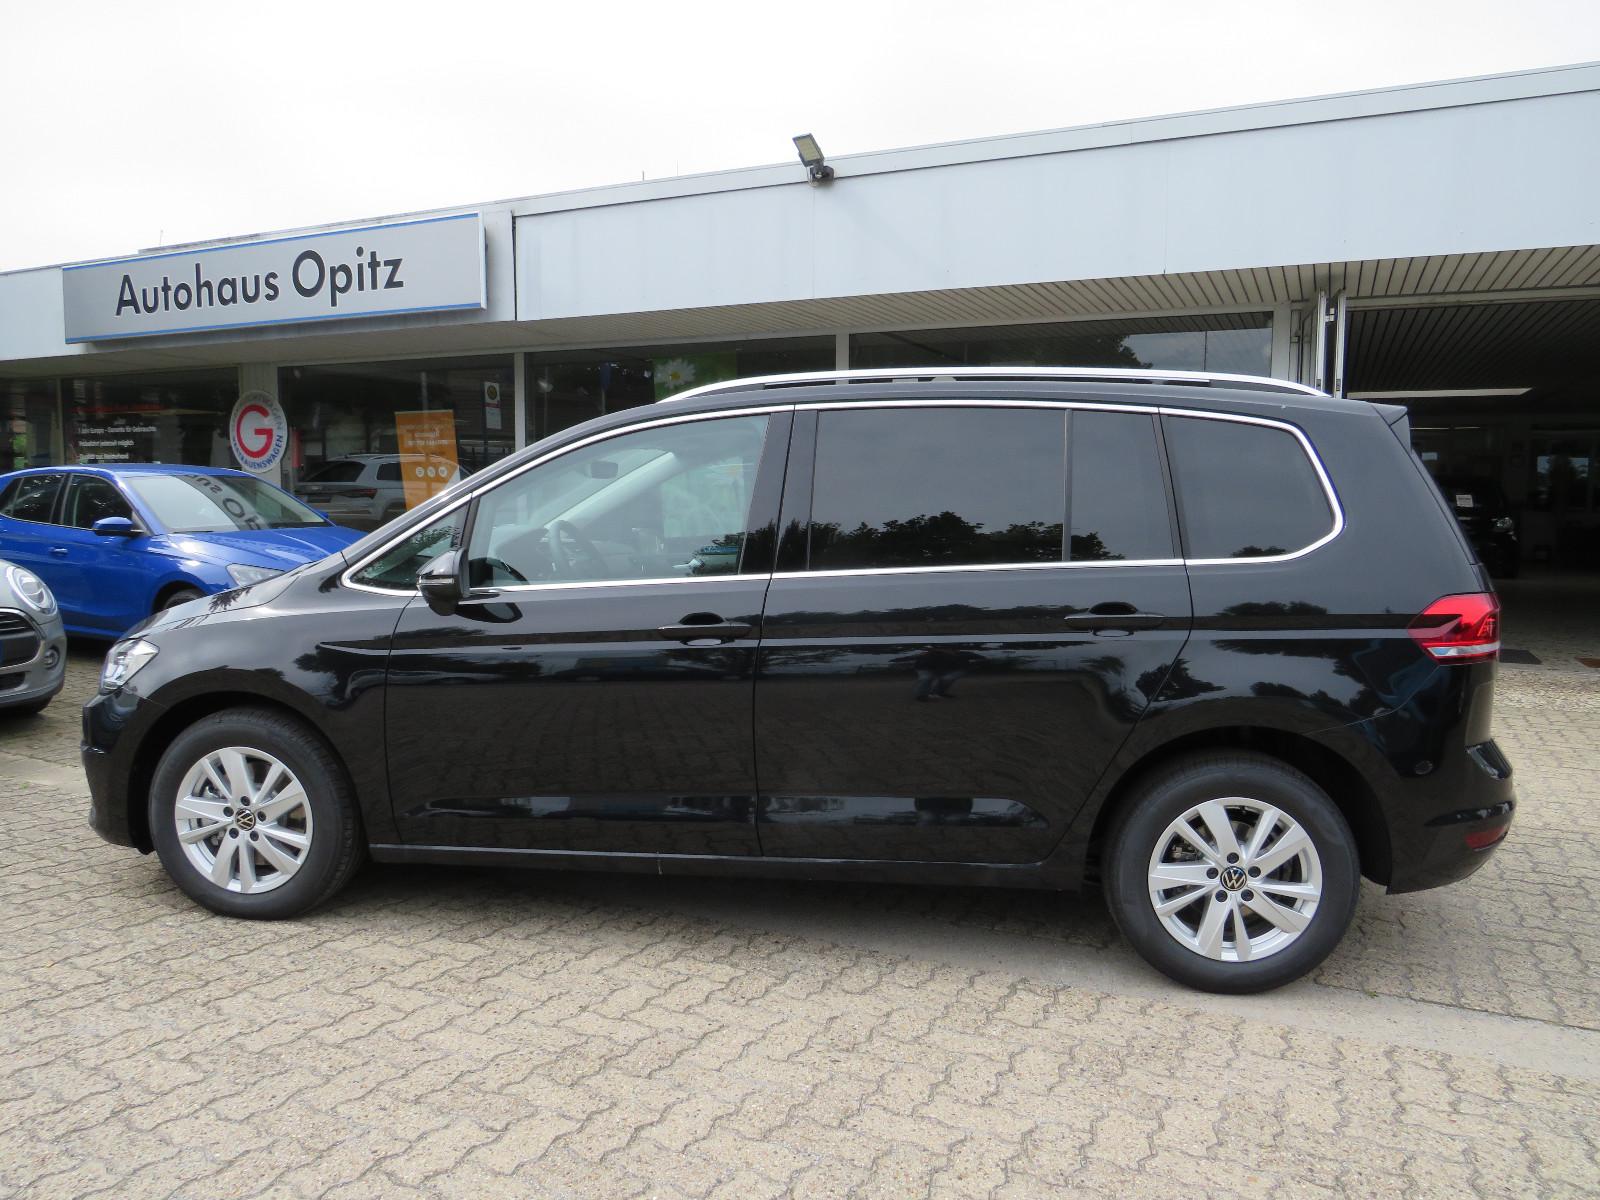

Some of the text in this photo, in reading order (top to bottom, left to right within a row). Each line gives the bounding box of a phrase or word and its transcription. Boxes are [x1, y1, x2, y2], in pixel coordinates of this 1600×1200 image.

[115, 246, 404, 316] Autohaus Opitz
[236, 404, 274, 459] G
